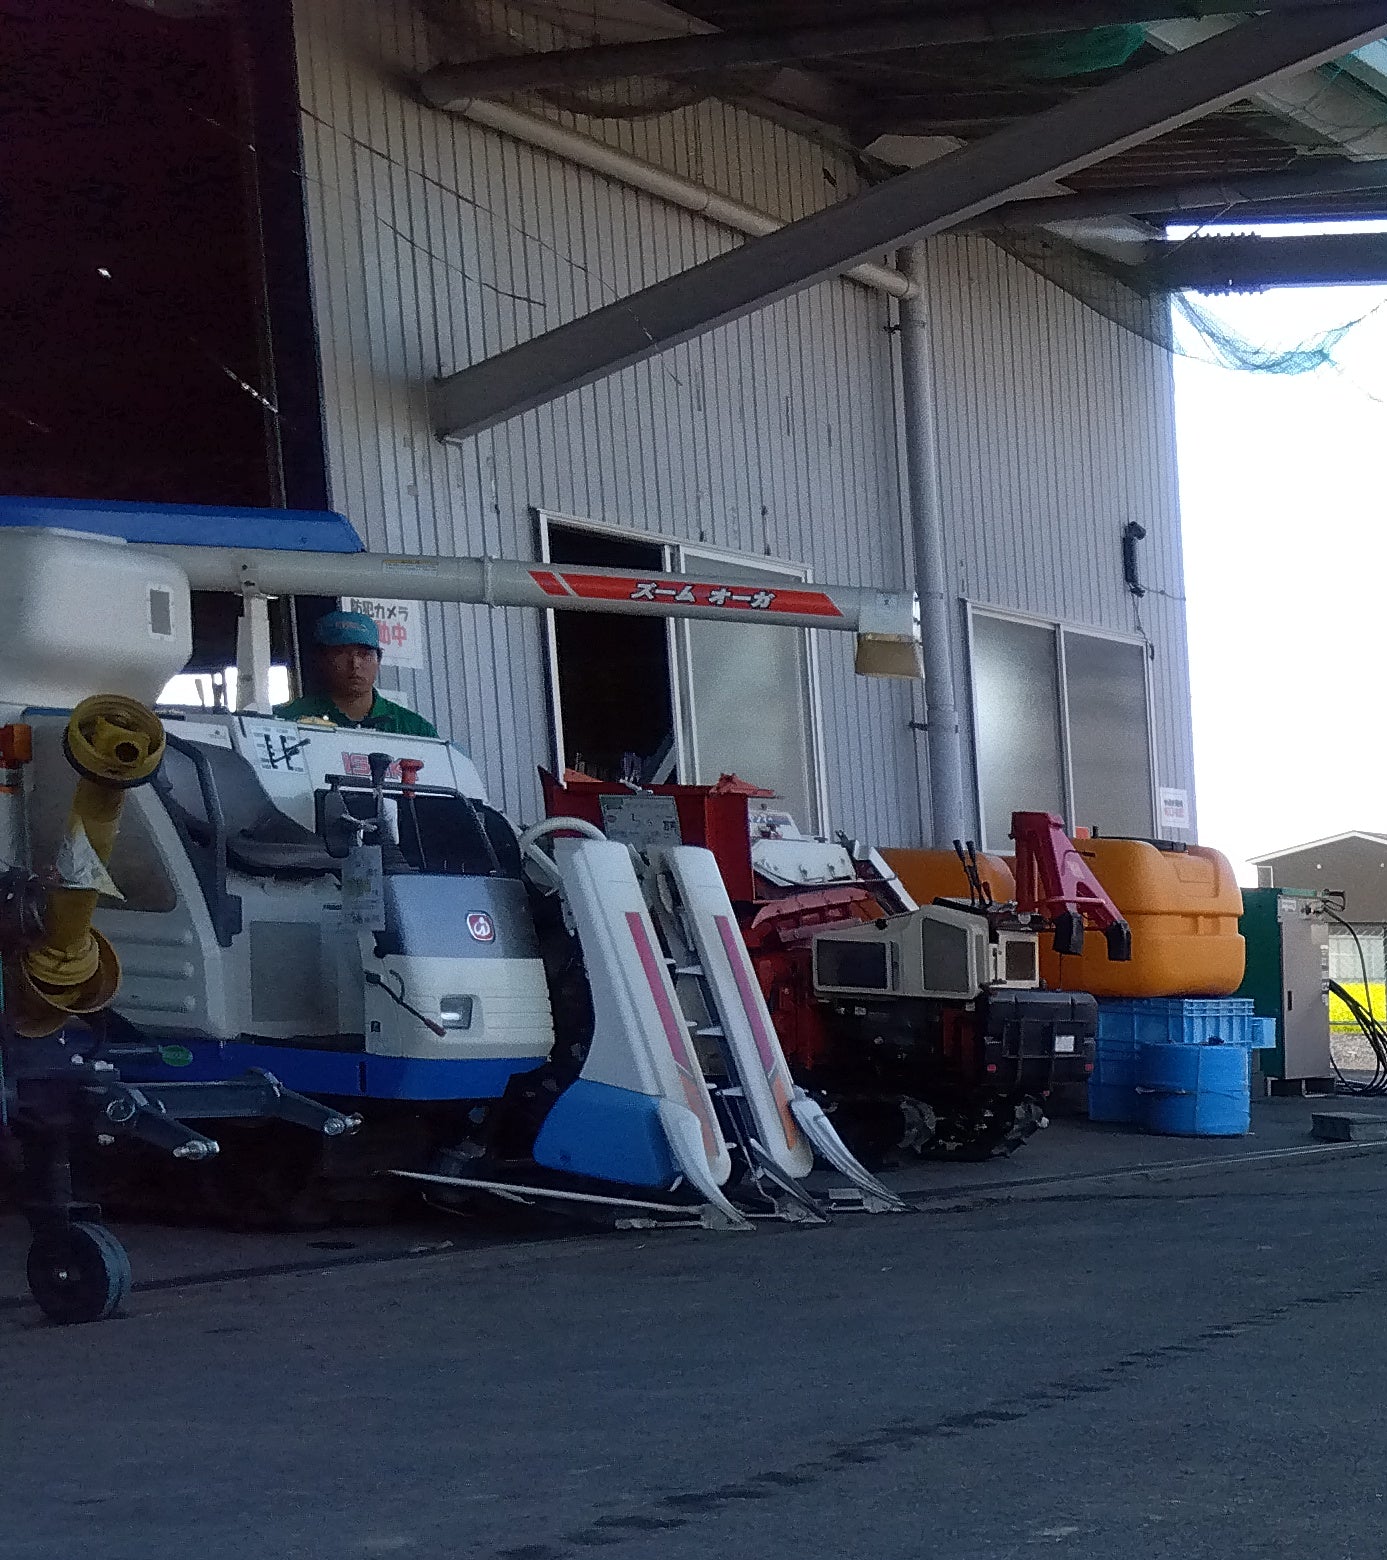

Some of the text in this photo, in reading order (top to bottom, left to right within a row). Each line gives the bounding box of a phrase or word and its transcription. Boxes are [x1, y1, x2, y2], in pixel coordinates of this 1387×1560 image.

[631, 582, 776, 608] ズーム オーガ
